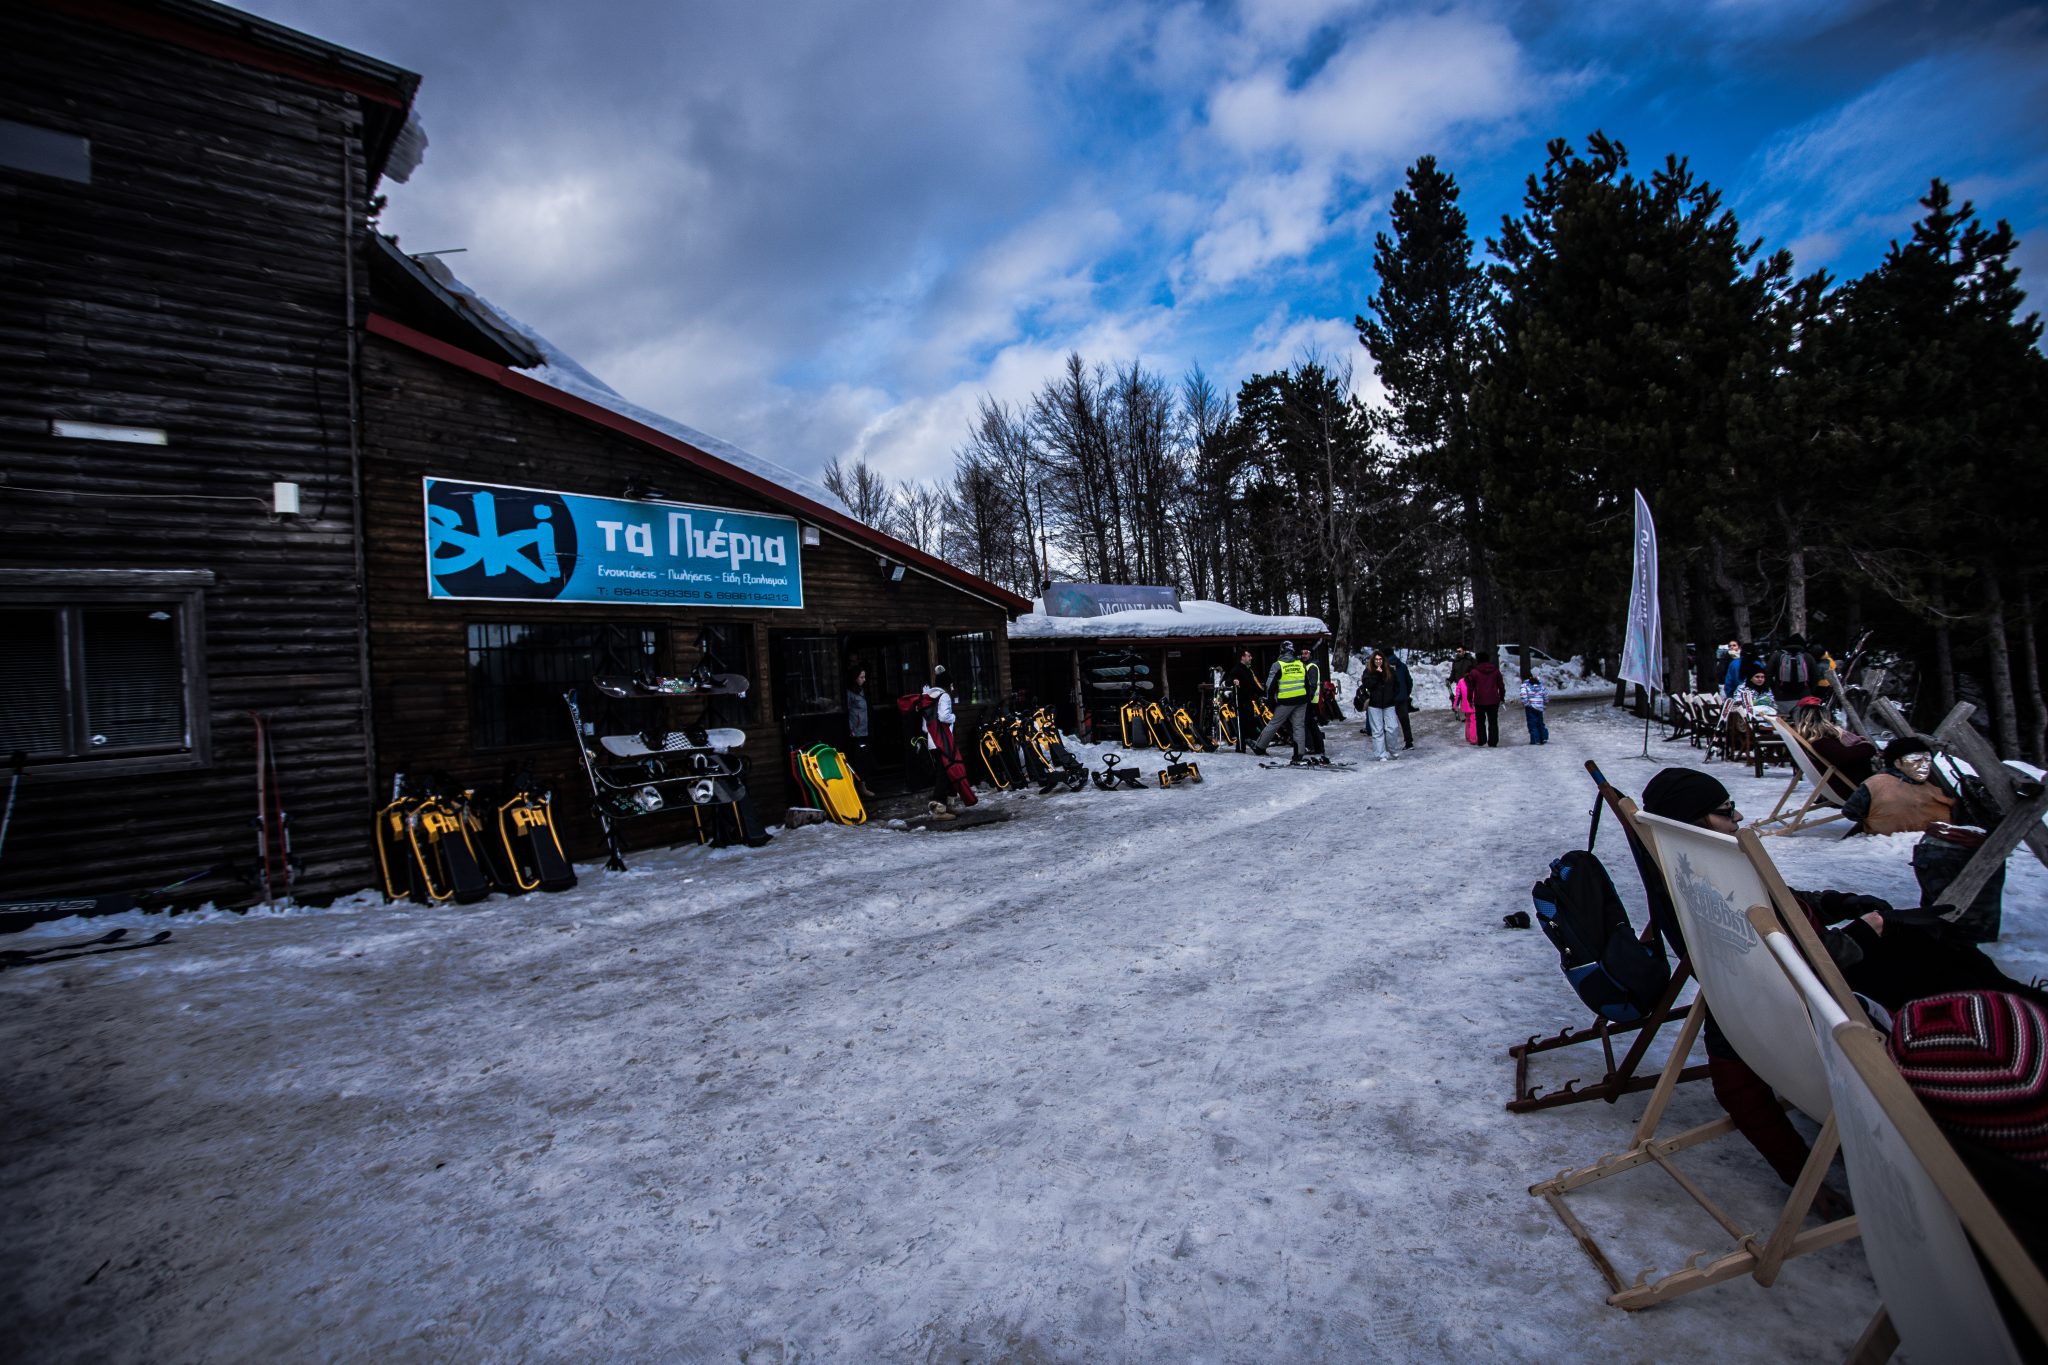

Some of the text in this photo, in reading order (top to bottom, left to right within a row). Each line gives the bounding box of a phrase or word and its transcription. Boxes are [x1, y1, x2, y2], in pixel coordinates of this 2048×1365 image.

[428, 491, 561, 584] ski
[596, 511, 787, 571] τα Πιέρια
[668, 568, 712, 583] Πωλήσεις
[722, 571, 741, 586] Είδη
[743, 572, 788, 587] Εξοπλισμού
[703, 590, 712, 599] &
